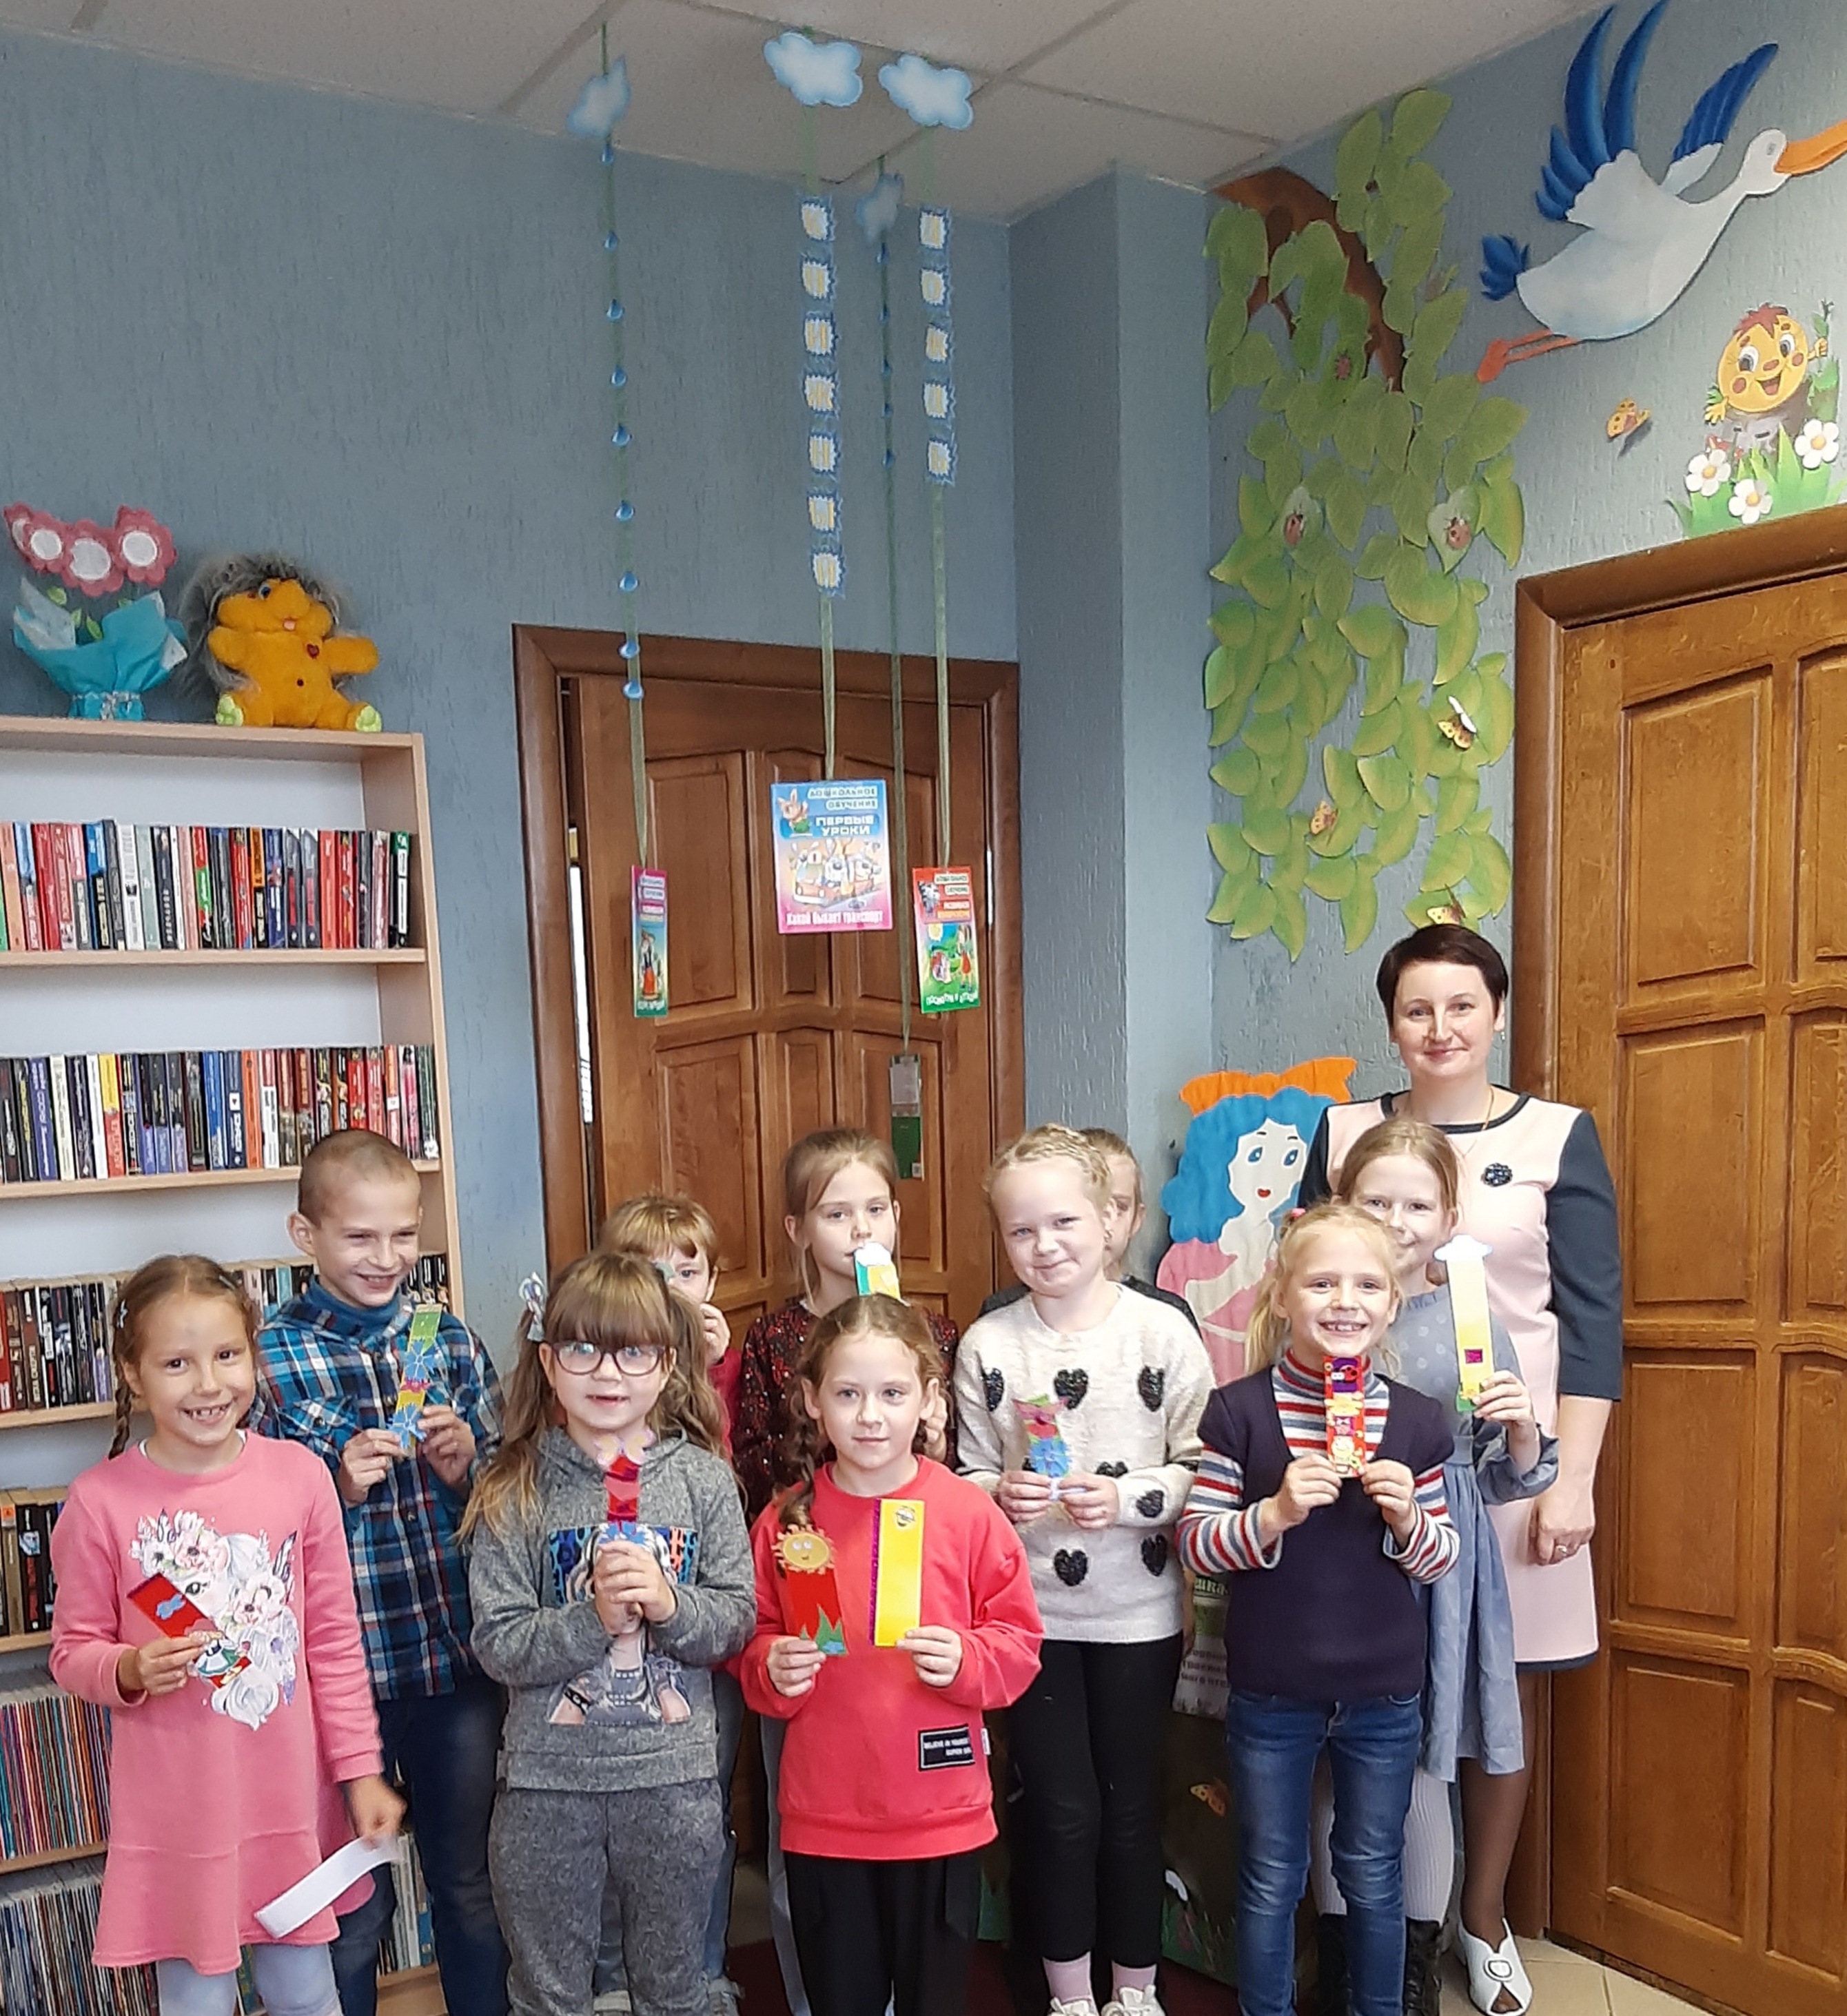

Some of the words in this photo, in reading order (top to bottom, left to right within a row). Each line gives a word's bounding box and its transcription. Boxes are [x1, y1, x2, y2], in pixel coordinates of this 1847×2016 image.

[808, 788, 876, 797] ДОШКОЛЬНОЕ
[828, 799, 876, 809] ОБУЧЕНИЕ
[815, 814, 875, 826] ПЕРВЫЕ
[821, 825, 870, 836] УРОКИ
